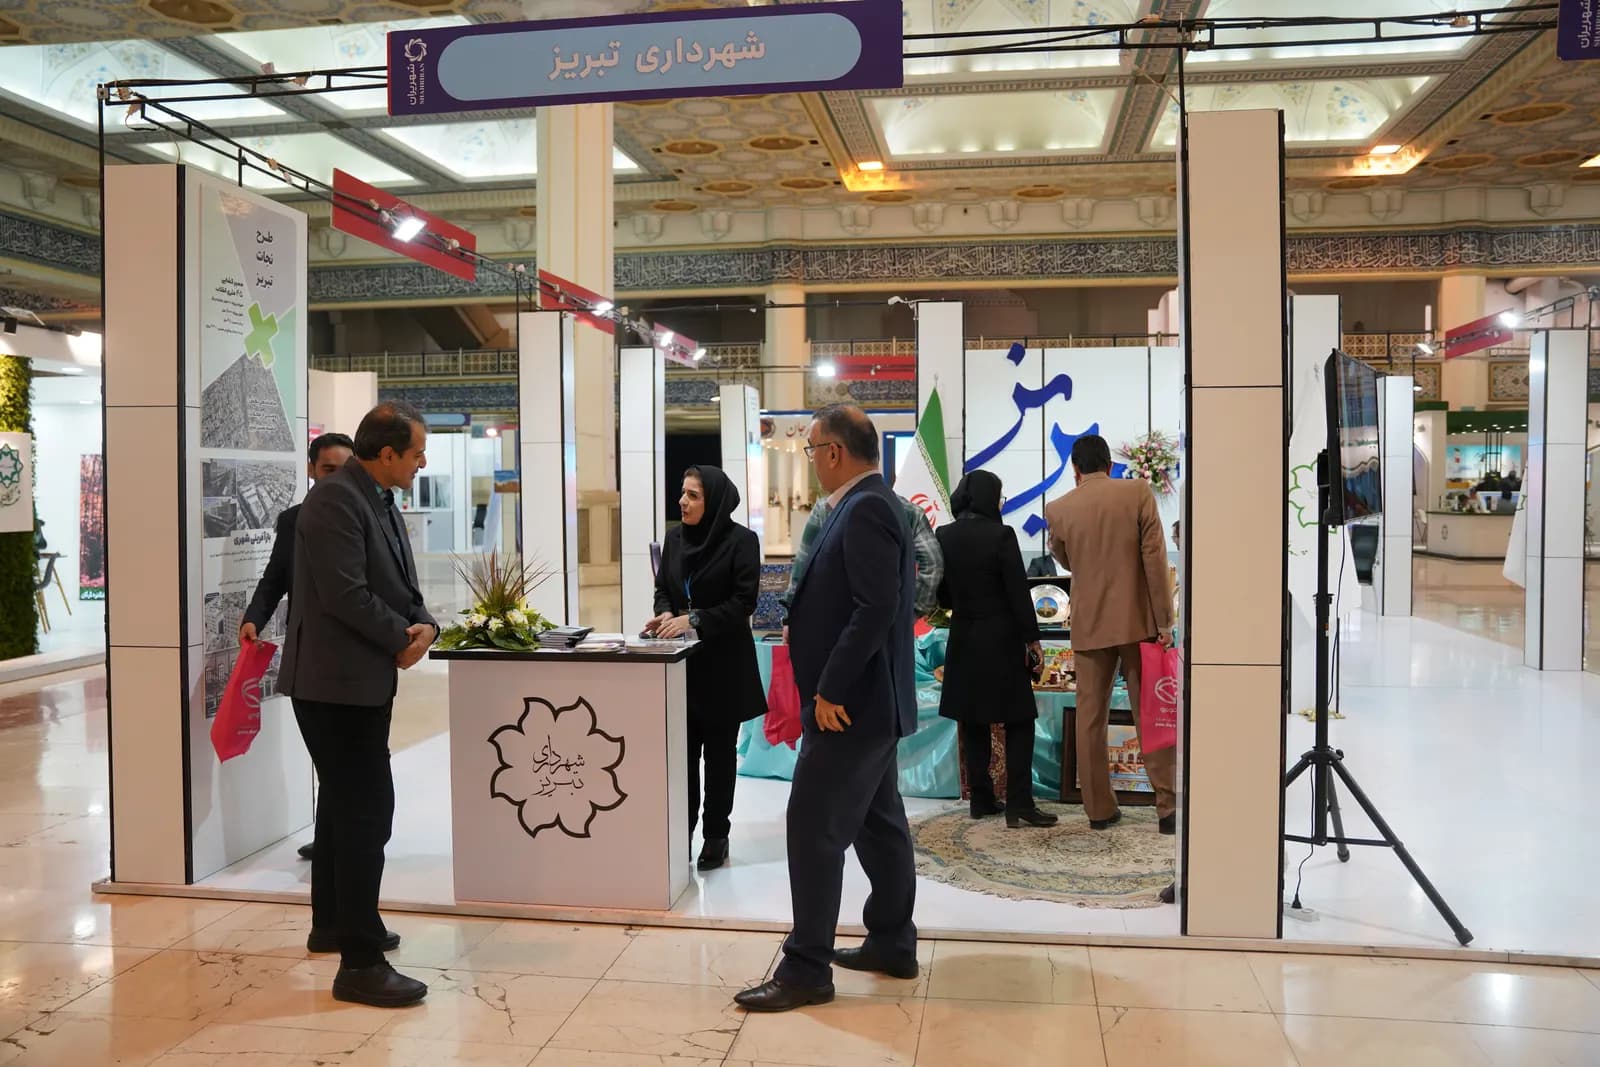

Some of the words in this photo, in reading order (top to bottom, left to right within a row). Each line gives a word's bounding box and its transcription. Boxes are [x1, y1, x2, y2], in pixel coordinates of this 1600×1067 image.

[547, 40, 620, 80] تبریز
[636, 32, 766, 75] شهرداری
[408, 63, 417, 105] شهریران
[256, 230, 273, 243] طرح
[256, 251, 273, 267] نجات
[256, 272, 272, 289] تبریز
[532, 735, 585, 774] شهرداری
[532, 771, 585, 797] تبریز
